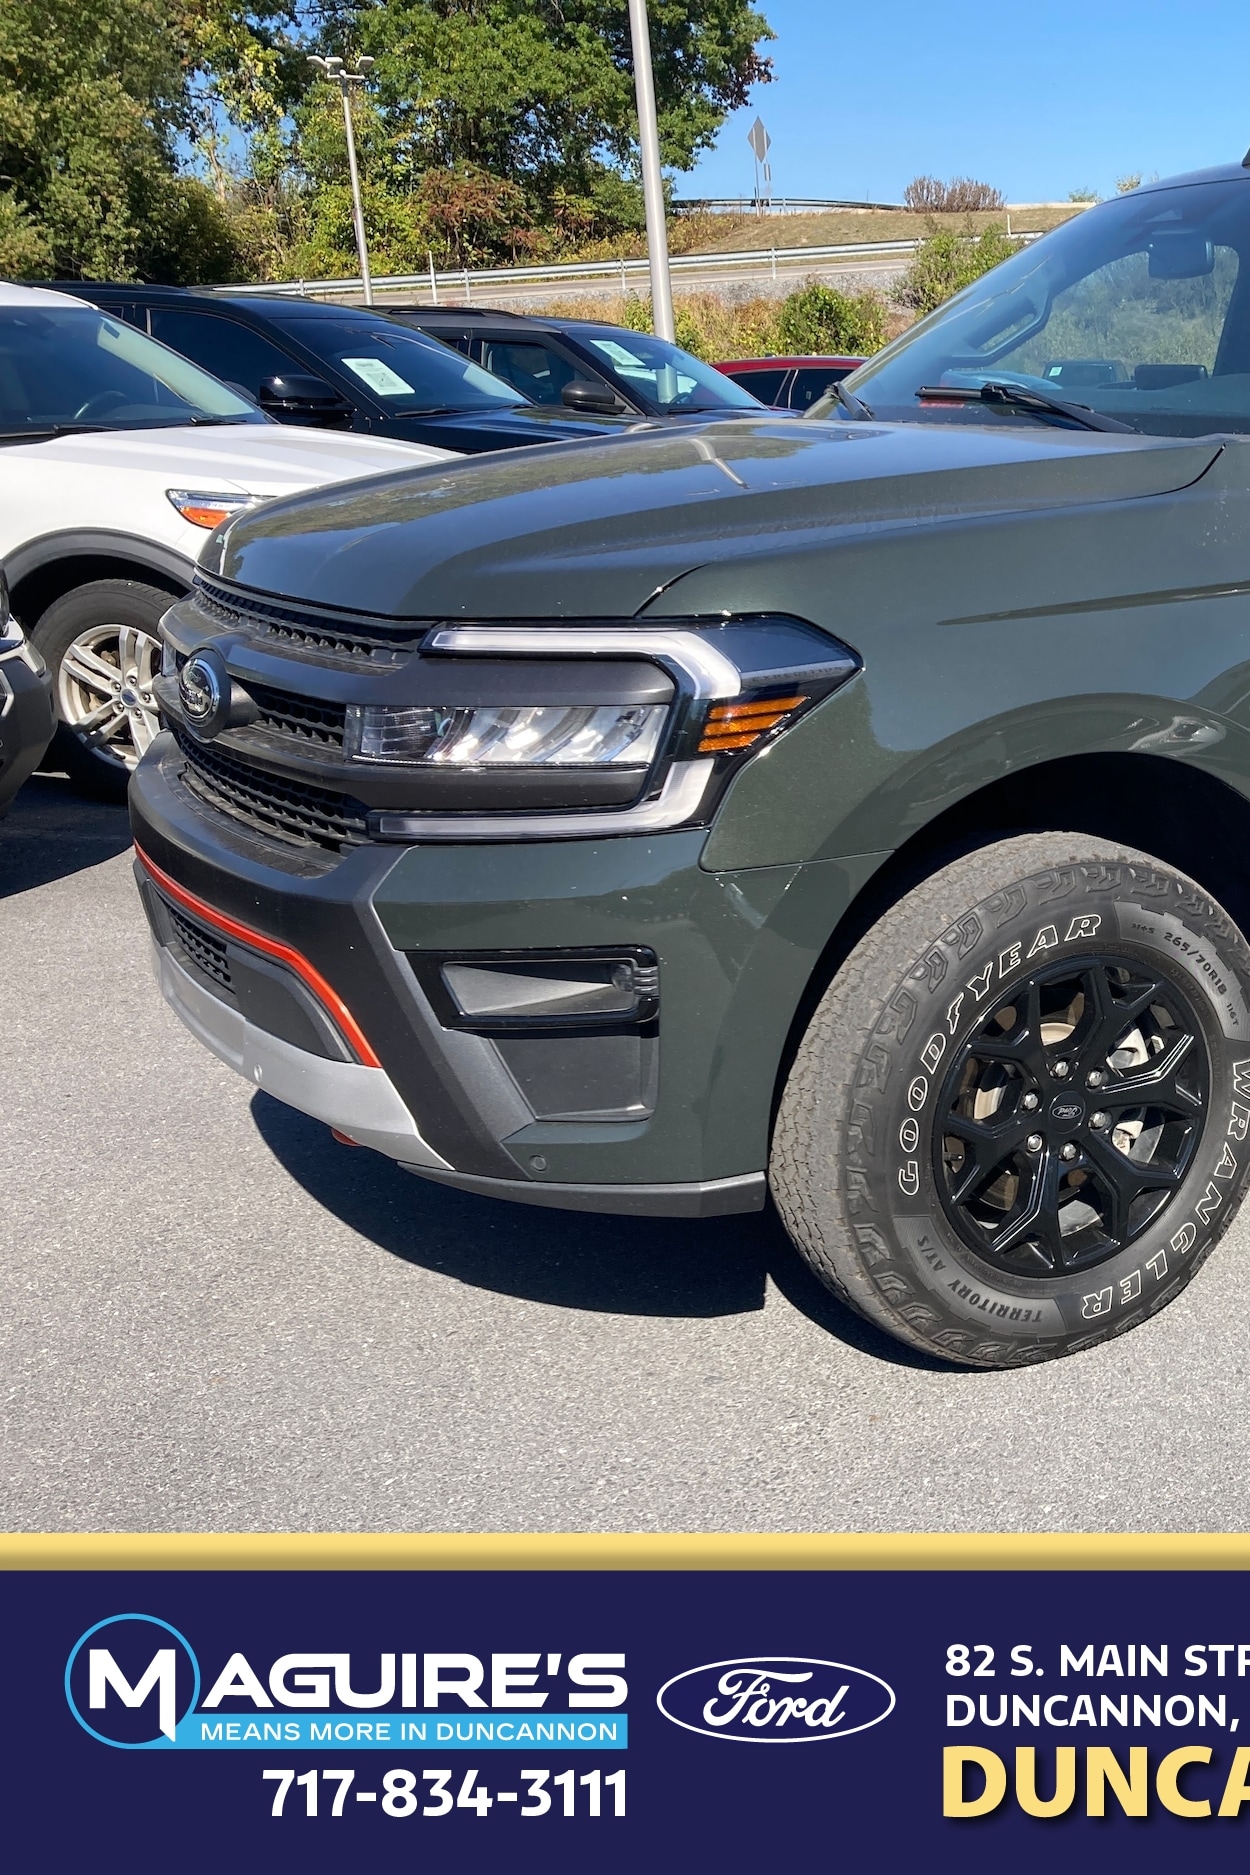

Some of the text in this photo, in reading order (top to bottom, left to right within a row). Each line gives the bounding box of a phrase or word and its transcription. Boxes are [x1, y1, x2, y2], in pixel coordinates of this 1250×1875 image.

[899, 913, 1102, 1196] GOODYEAR
[917, 1235, 947, 1272] AT/S
[947, 1278, 1043, 1323] TERRITORY
